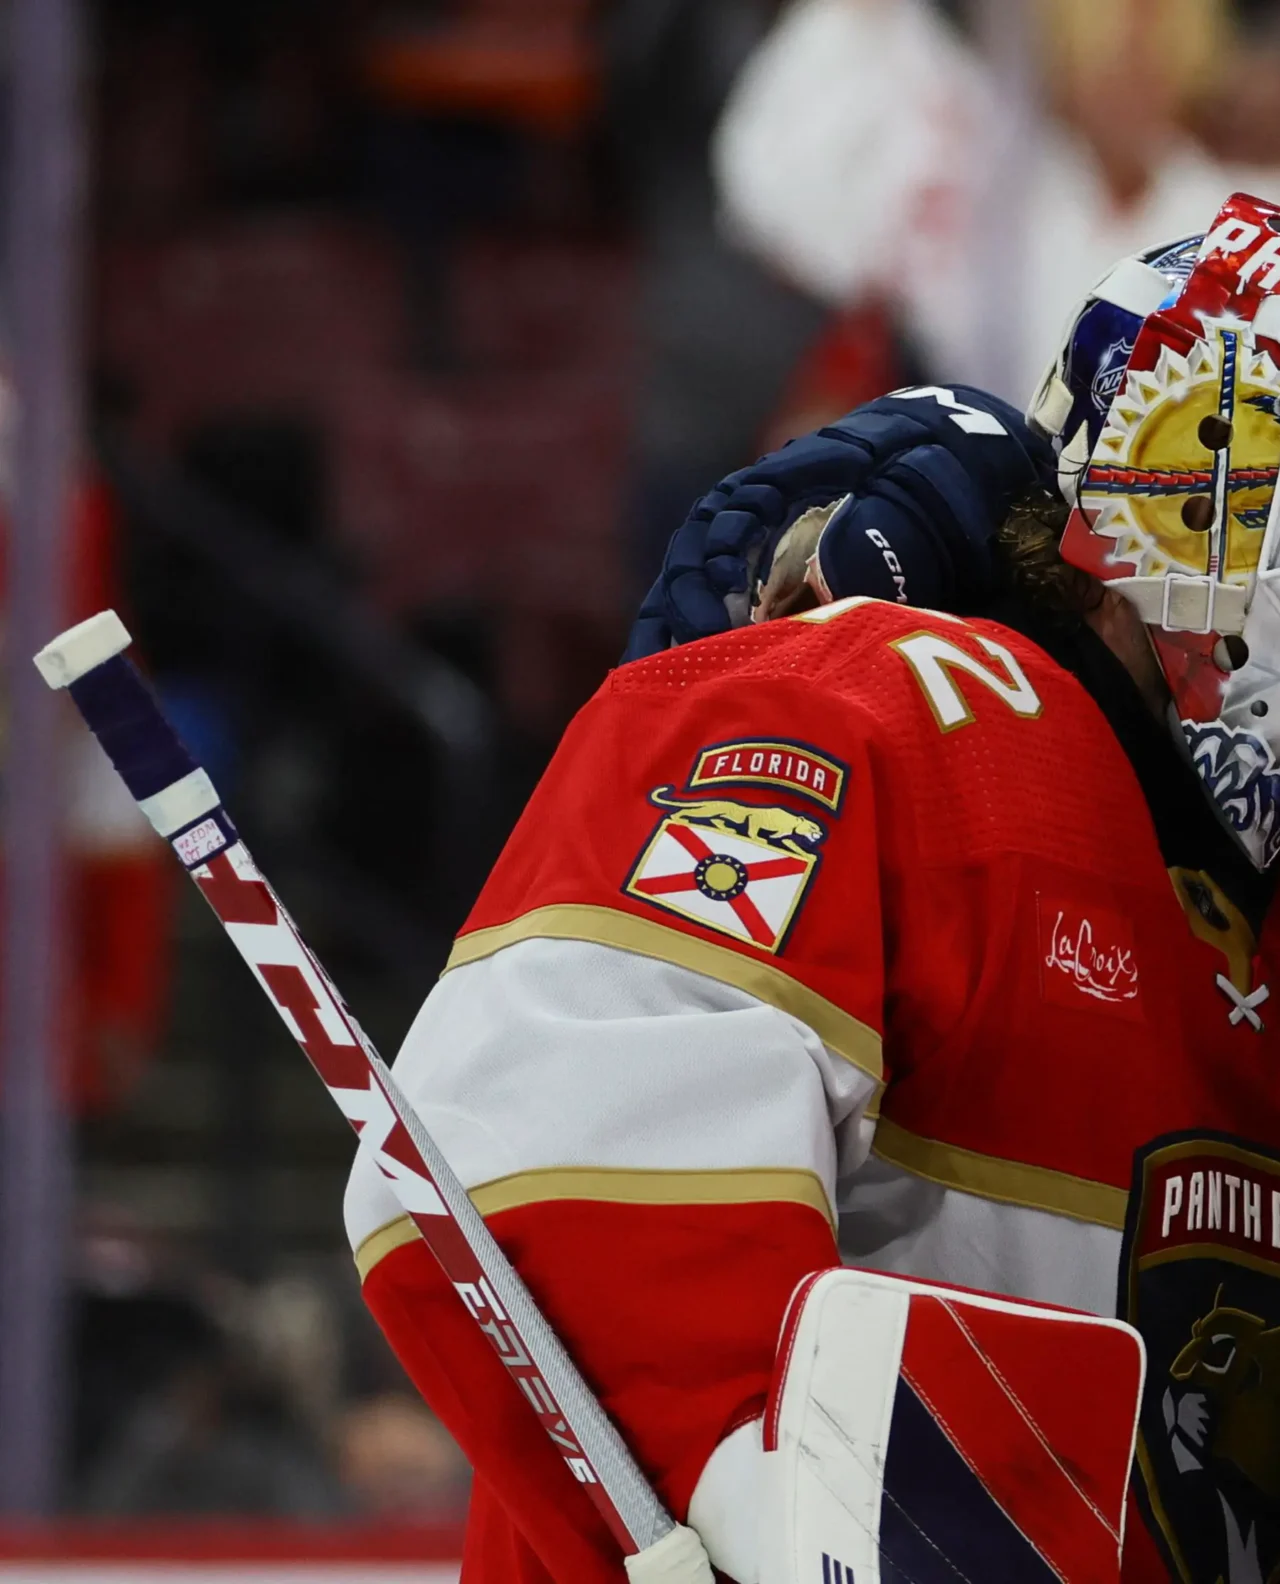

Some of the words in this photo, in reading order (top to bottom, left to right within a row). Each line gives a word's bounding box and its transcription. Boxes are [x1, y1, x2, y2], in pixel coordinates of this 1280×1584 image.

[865, 528, 908, 604] CCM
[713, 752, 826, 791] FLORIDA
[1045, 911, 1138, 1000] LaCroix
